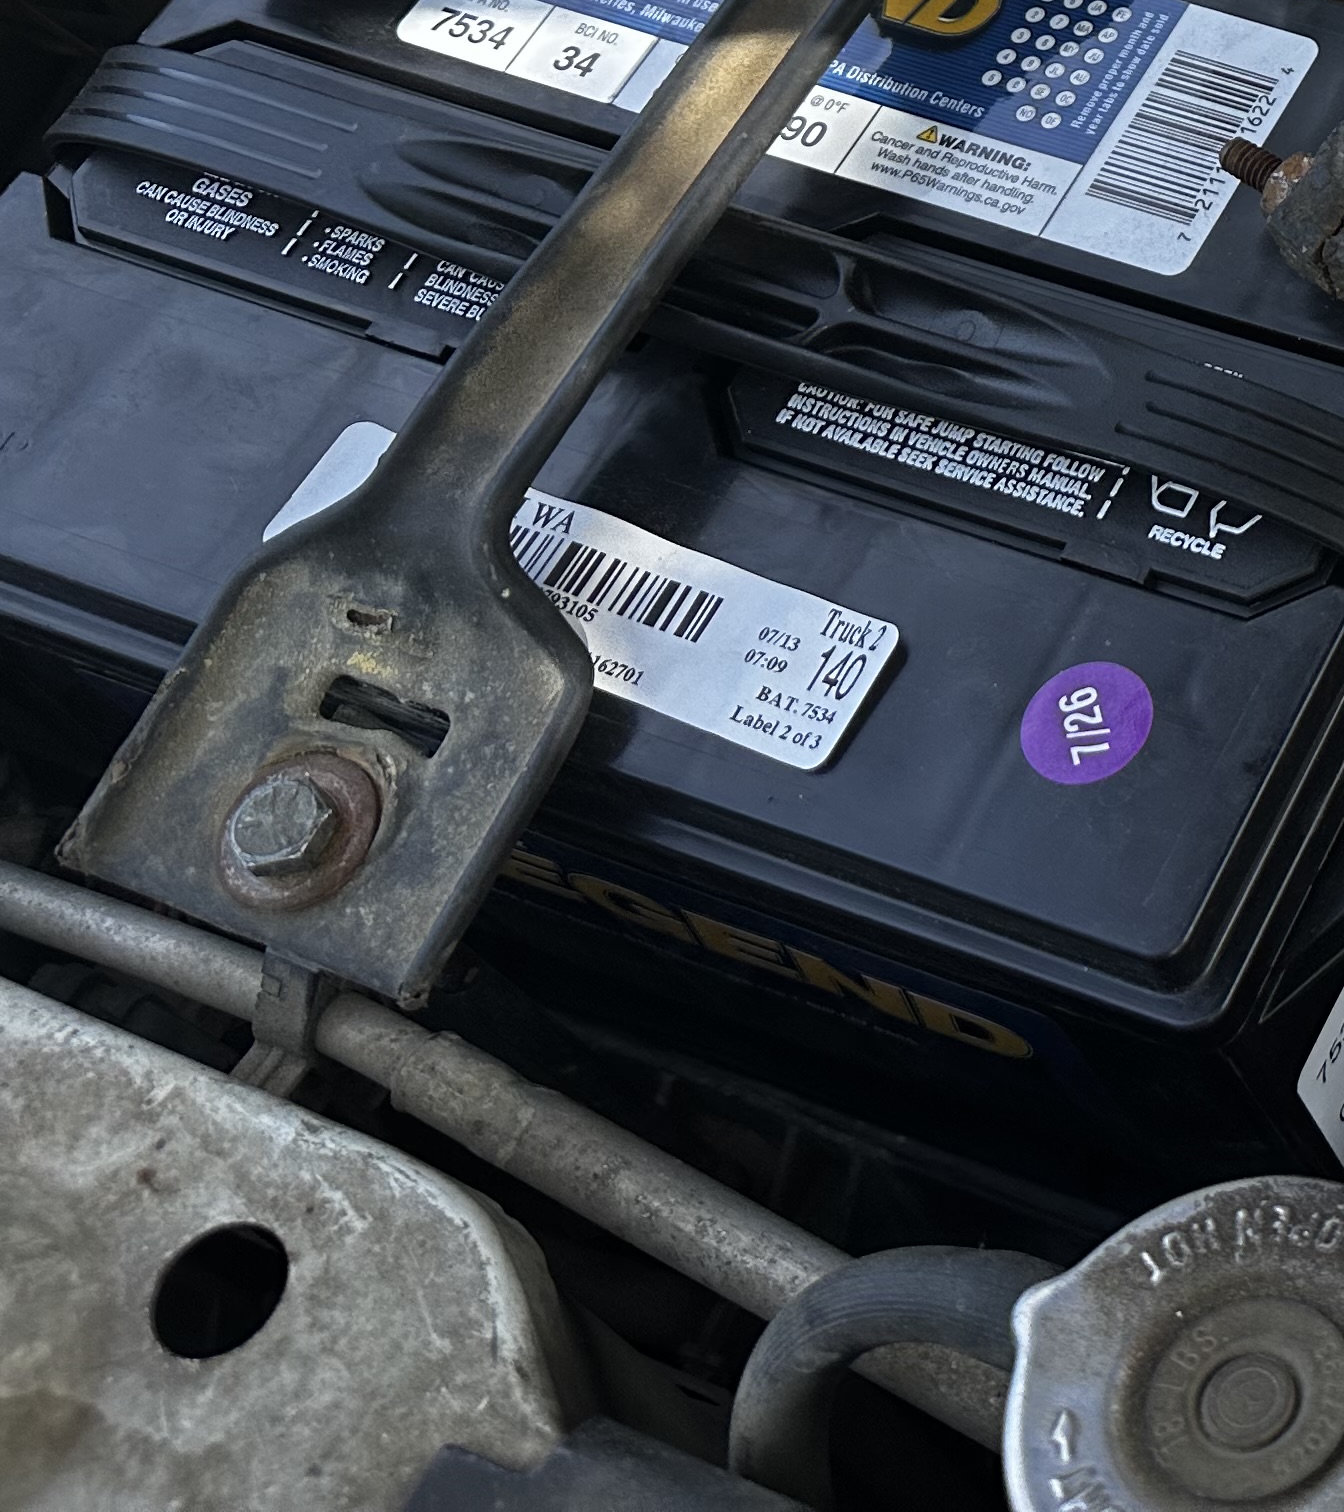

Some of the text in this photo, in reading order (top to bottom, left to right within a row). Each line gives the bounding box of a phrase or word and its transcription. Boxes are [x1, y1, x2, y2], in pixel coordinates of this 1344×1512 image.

[1091, 3, 1103, 12] JA
[431, 6, 515, 51] 7534
[574, 22, 620, 46] BCI NO.
[1101, 31, 1114, 39] AP
[552, 45, 601, 78] 34
[1070, 11, 1155, 128] Remove proper month and
[1085, 111, 1104, 135] year
[1112, 81, 1126, 92] to
[1120, 57, 1142, 82] show
[1136, 33, 1156, 56] date
[1154, 13, 1170, 34] sold
[810, 94, 824, 107] @
[846, 63, 929, 102] Distribution
[929, 90, 986, 119] Centers
[871, 130, 1058, 196] Cancer and Reproductive Harm.
[938, 133, 1032, 172] WARNING:
[1177, 231, 1191, 242] 7
[1240, 94, 1277, 134] 1622
[1281, 66, 1295, 76] 4
[191, 178, 254, 207] GASES
[870, 160, 1027, 216] www.P65Warnings.ca.gov
[877, 146, 1035, 205] Wash hands after handling.
[136, 180, 280, 237] CAN CAUSE BLINDNESS
[165, 208, 236, 241] OR INJURY
[436, 260, 468, 278] CAN
[414, 288, 470, 316] SEVERE
[775, 407, 1085, 518] IF NOT AVAILABLE SEEK SERVICE ASSISTANCE.
[787, 393, 1092, 501] INSTRUCTIONS IN VEHICLE OWNERS MANUAL.
[894, 409, 935, 432] SAFE
[931, 420, 976, 443] JUMP
[973, 432, 1045, 464] STARTING
[1042, 453, 1106, 483] FOLLOW
[532, 501, 576, 535] WA
[1147, 524, 1227, 561] RECYCLE
[758, 626, 802, 652] 07/13
[820, 608, 887, 651] Truck 2
[588, 652, 644, 686] 162701
[744, 648, 788, 674] 07:09
[806, 644, 867, 701] 140
[756, 685, 838, 725] BAT. 7534
[729, 704, 823, 750] Label 2 of 3
[1058, 685, 1111, 767] 7/26
